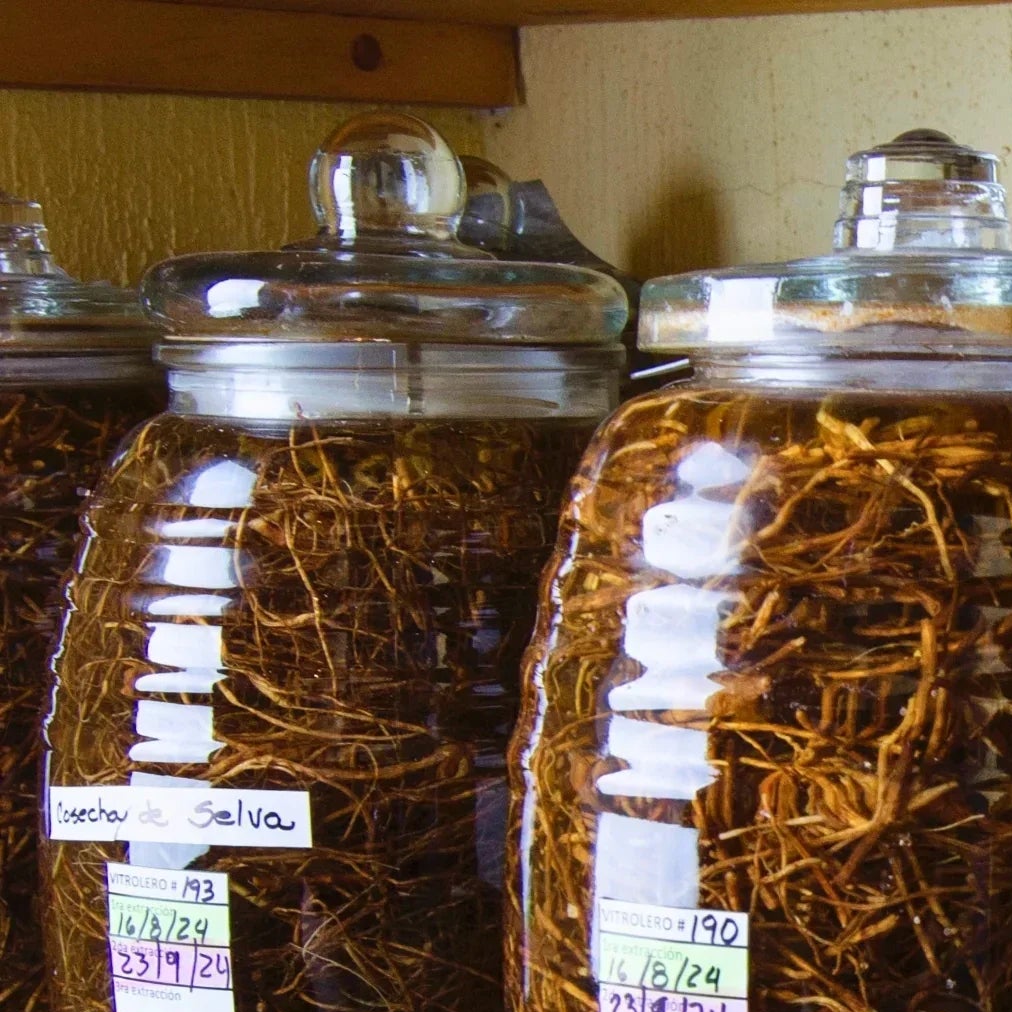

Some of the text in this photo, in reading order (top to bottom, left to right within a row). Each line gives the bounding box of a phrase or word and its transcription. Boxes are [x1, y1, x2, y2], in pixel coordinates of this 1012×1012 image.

[57, 797, 297, 831] Cosecha de Selva
[109, 872, 168, 890] VITROLERO
[182, 876, 215, 902] 193
[117, 907, 209, 945] 16/8/24
[601, 908, 673, 932] VITROLERO
[691, 914, 740, 945] 190
[608, 955, 721, 994] 16/8/24
